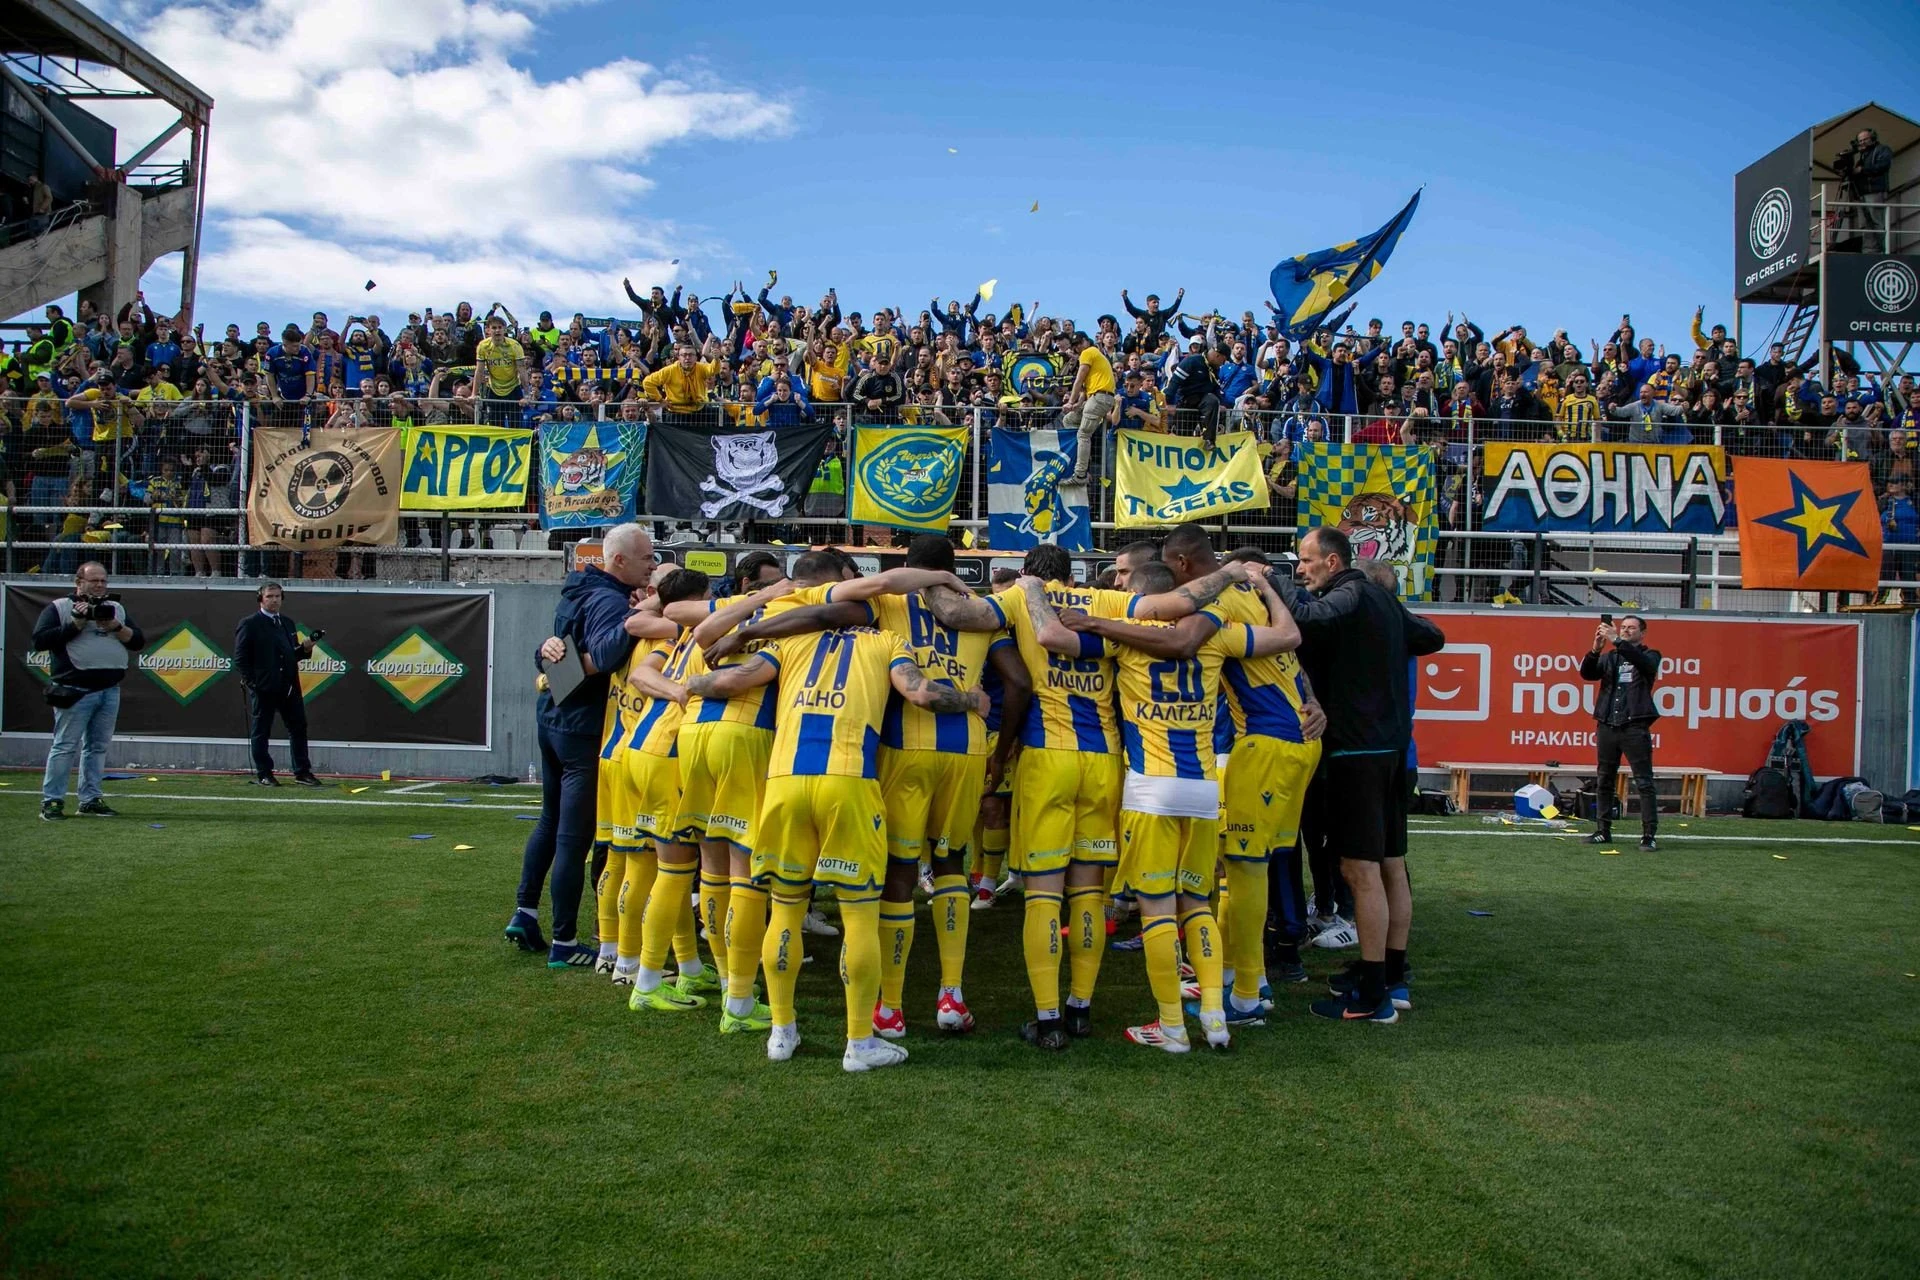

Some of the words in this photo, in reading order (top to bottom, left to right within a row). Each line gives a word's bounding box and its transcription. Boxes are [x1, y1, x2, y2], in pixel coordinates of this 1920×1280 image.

[1745, 272, 1758, 286] OFI
[1760, 259, 1785, 279] CRETE
[1786, 253, 1797, 267] FC
[1850, 321, 1870, 331] OFI
[1873, 321, 1913, 333] CRETE
[404, 432, 530, 497] ΑΡΓΟΣ
[1483, 449, 1726, 529] ΑΘΗΝΑ
[602, 495, 616, 506] ego
[1124, 481, 1254, 519] TIGERS
[698, 559, 722, 567] Piraeus
[26, 651, 51, 669] Kap
[138, 654, 183, 671] Kappa
[183, 654, 232, 669] studies
[299, 657, 347, 673] studies
[367, 659, 414, 676] Kappa
[414, 660, 463, 674] studies
[793, 689, 846, 709] ALHO
[1136, 703, 1214, 721] ΚΑΛΤΣΑΣ
[710, 815, 748, 831] ΚΟΤΤΗΣ
[1092, 839, 1116, 850] ΚΟΤΤ
[818, 857, 859, 873] ΚΟΤΤΗΣ
